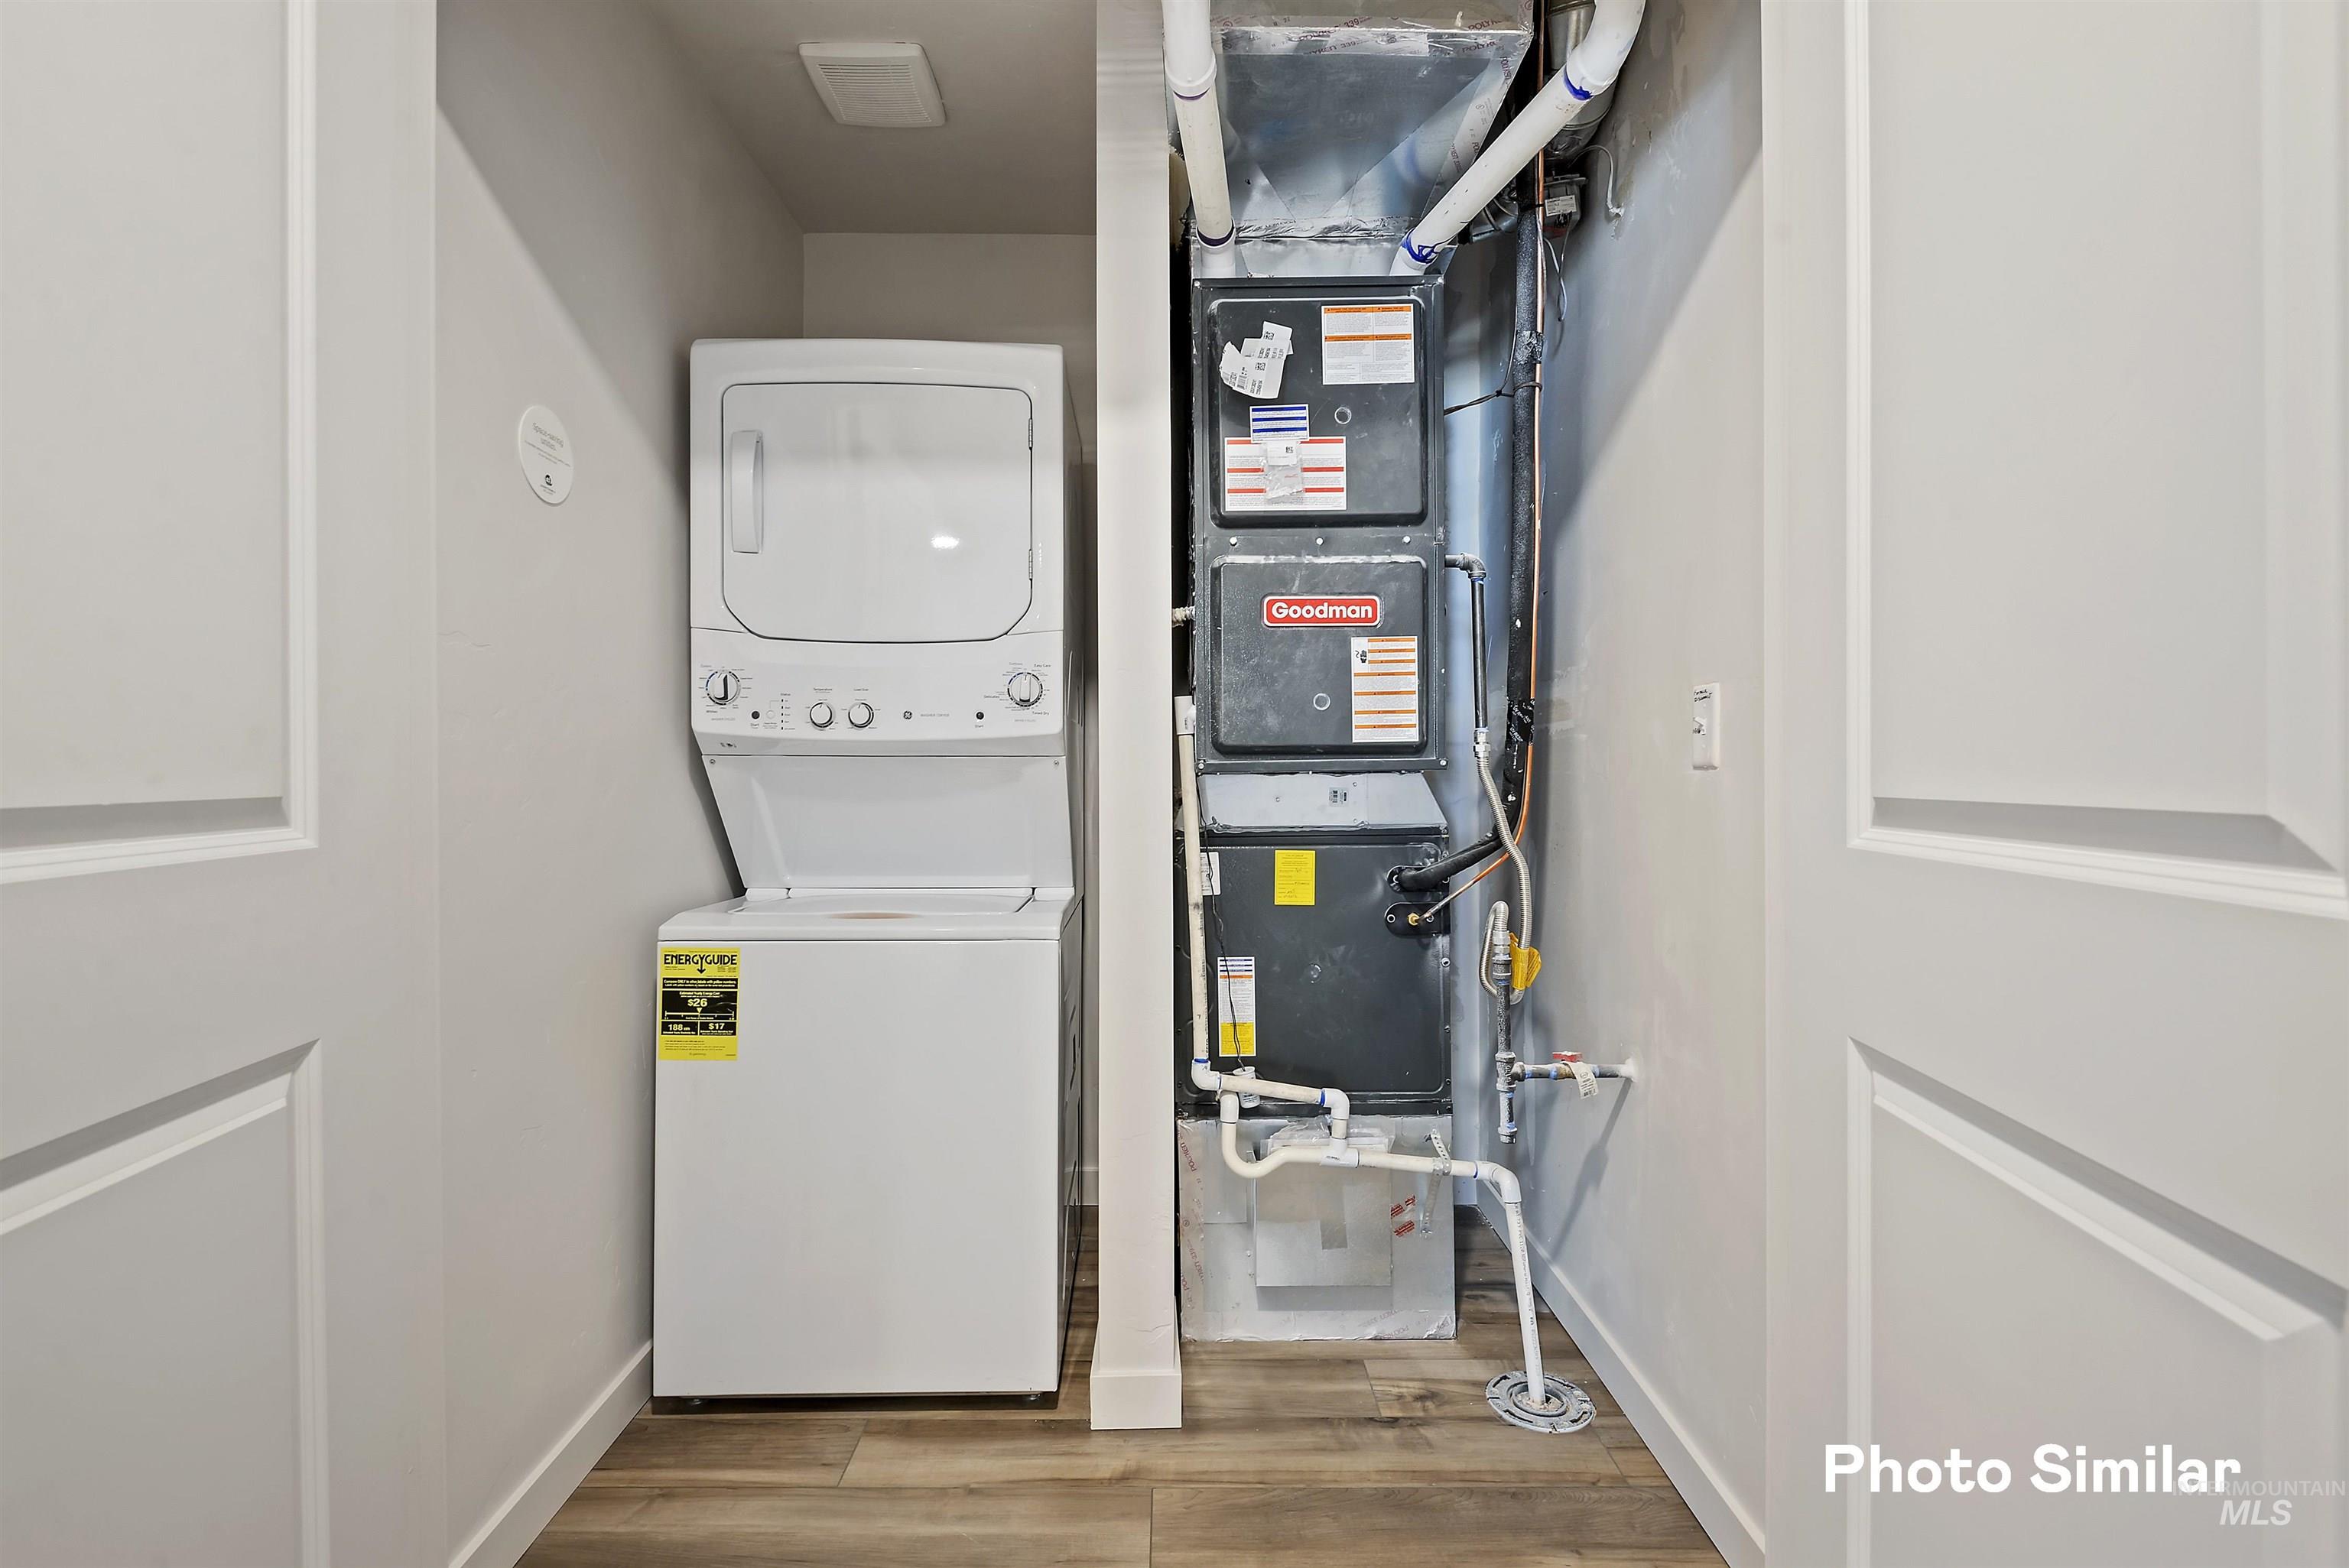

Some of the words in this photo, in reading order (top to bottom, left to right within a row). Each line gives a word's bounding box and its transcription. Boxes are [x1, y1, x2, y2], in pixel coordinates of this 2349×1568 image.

[1343, 18, 1360, 28] 339
[1272, 602, 1373, 618] Goodman
[664, 953, 738, 966] ENERGYGUIDE
[687, 998, 708, 1007] $26
